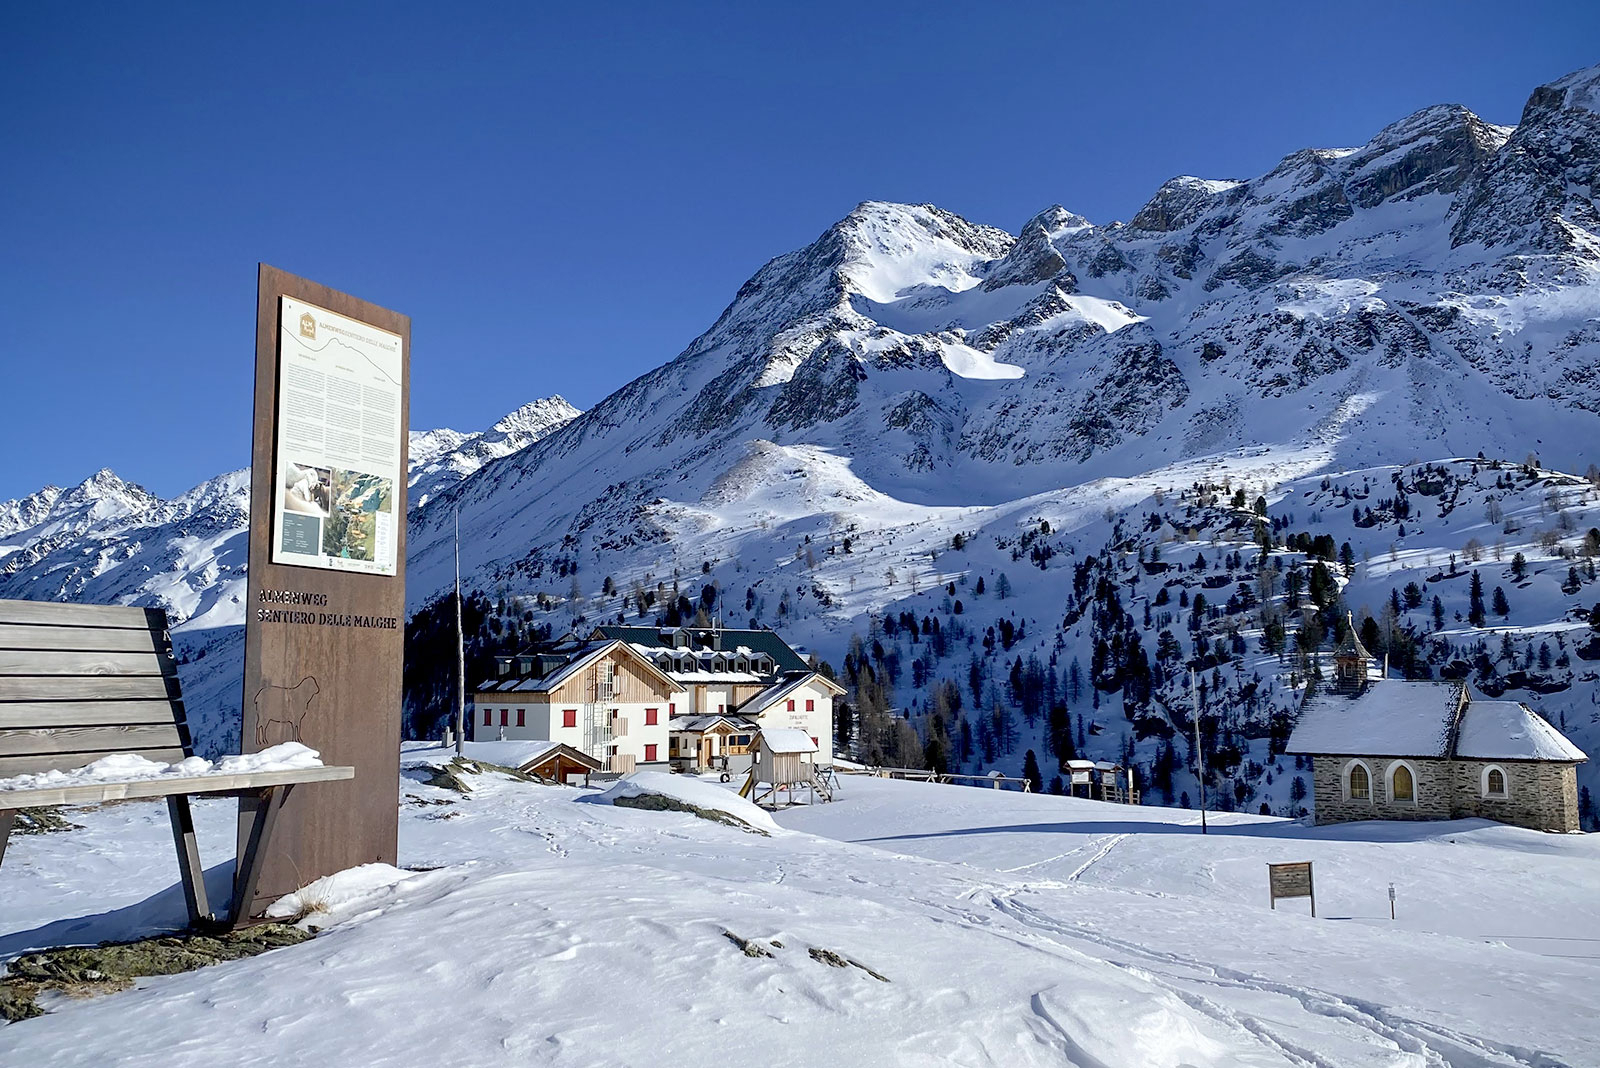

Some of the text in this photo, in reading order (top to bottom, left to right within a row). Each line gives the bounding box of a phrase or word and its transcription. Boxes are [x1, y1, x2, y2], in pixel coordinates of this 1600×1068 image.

[259, 589, 328, 606] ALMENWEG
[258, 608, 397, 630] SENTIERO DELLE MALGHE
